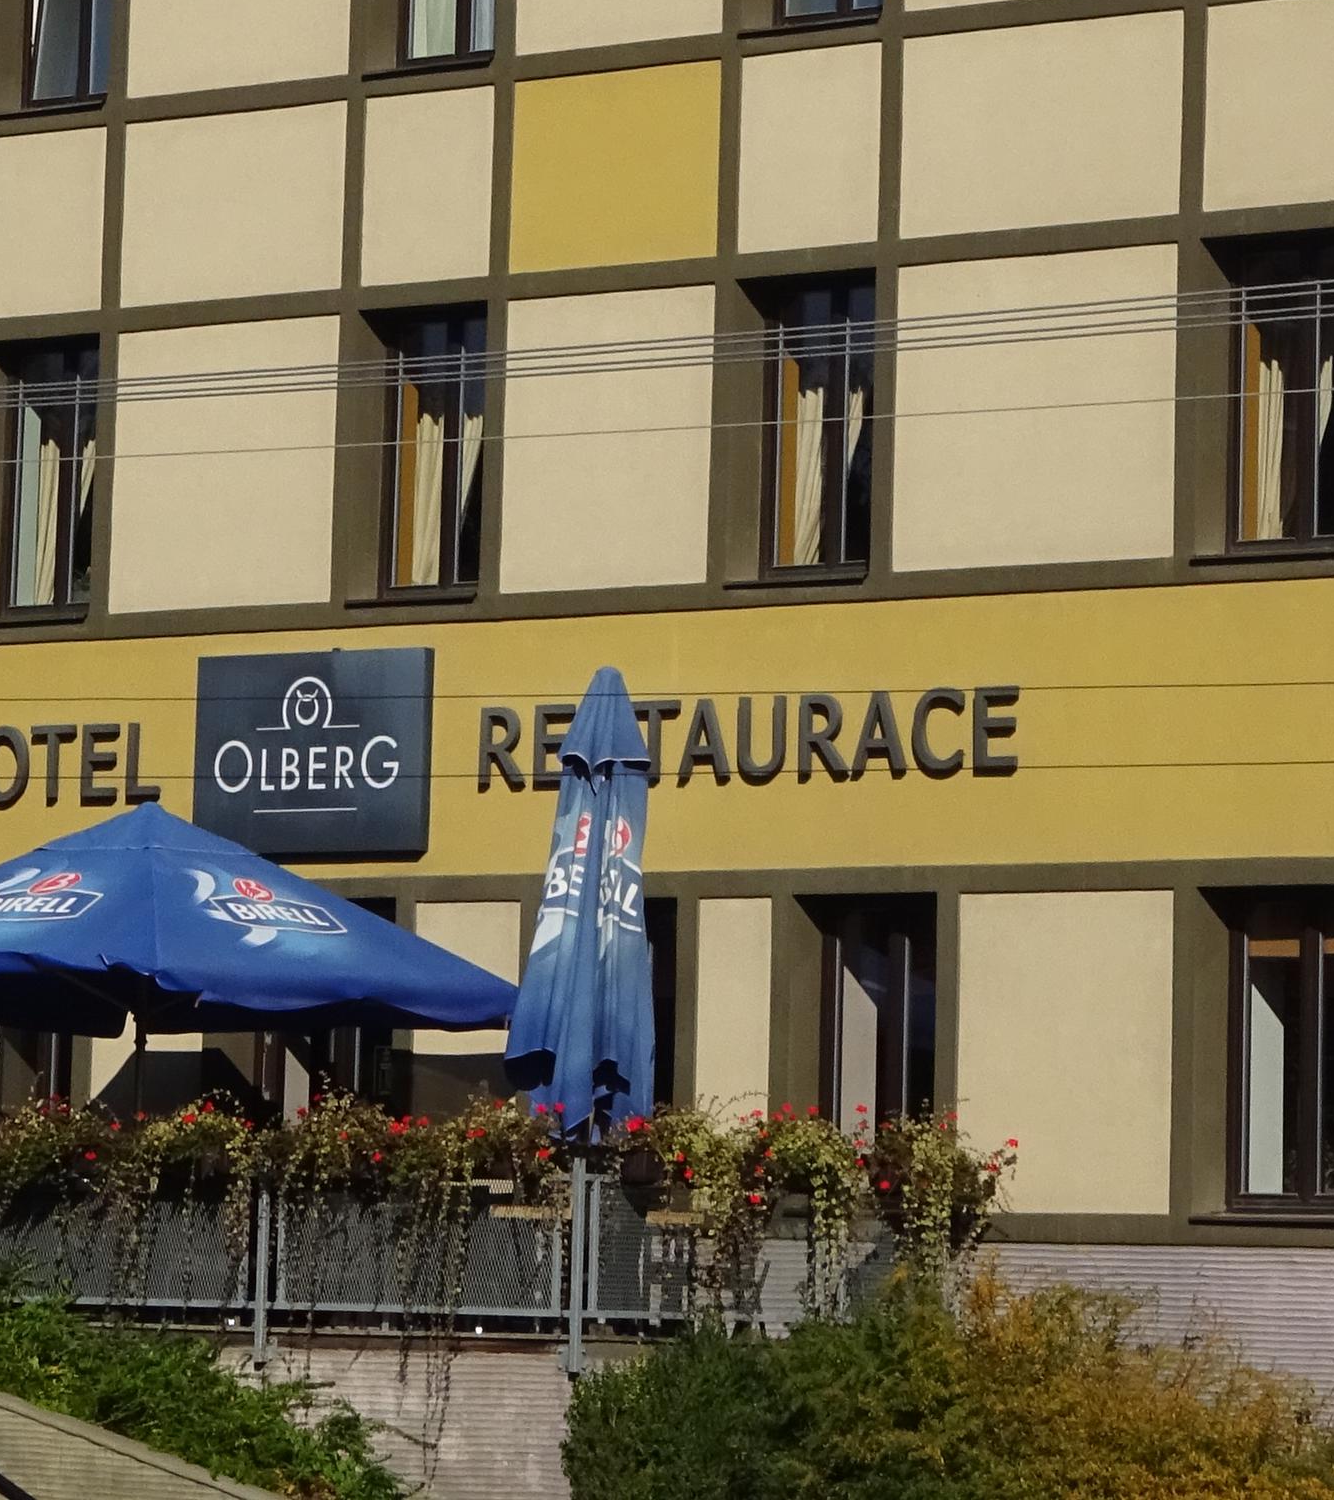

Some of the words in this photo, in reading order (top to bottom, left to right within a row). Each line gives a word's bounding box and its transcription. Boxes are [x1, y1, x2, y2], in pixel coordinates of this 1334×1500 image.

[214, 735, 399, 793] OLBERG
[477, 685, 1020, 794] RETAURACE
[227, 902, 330, 926] BIRELL
